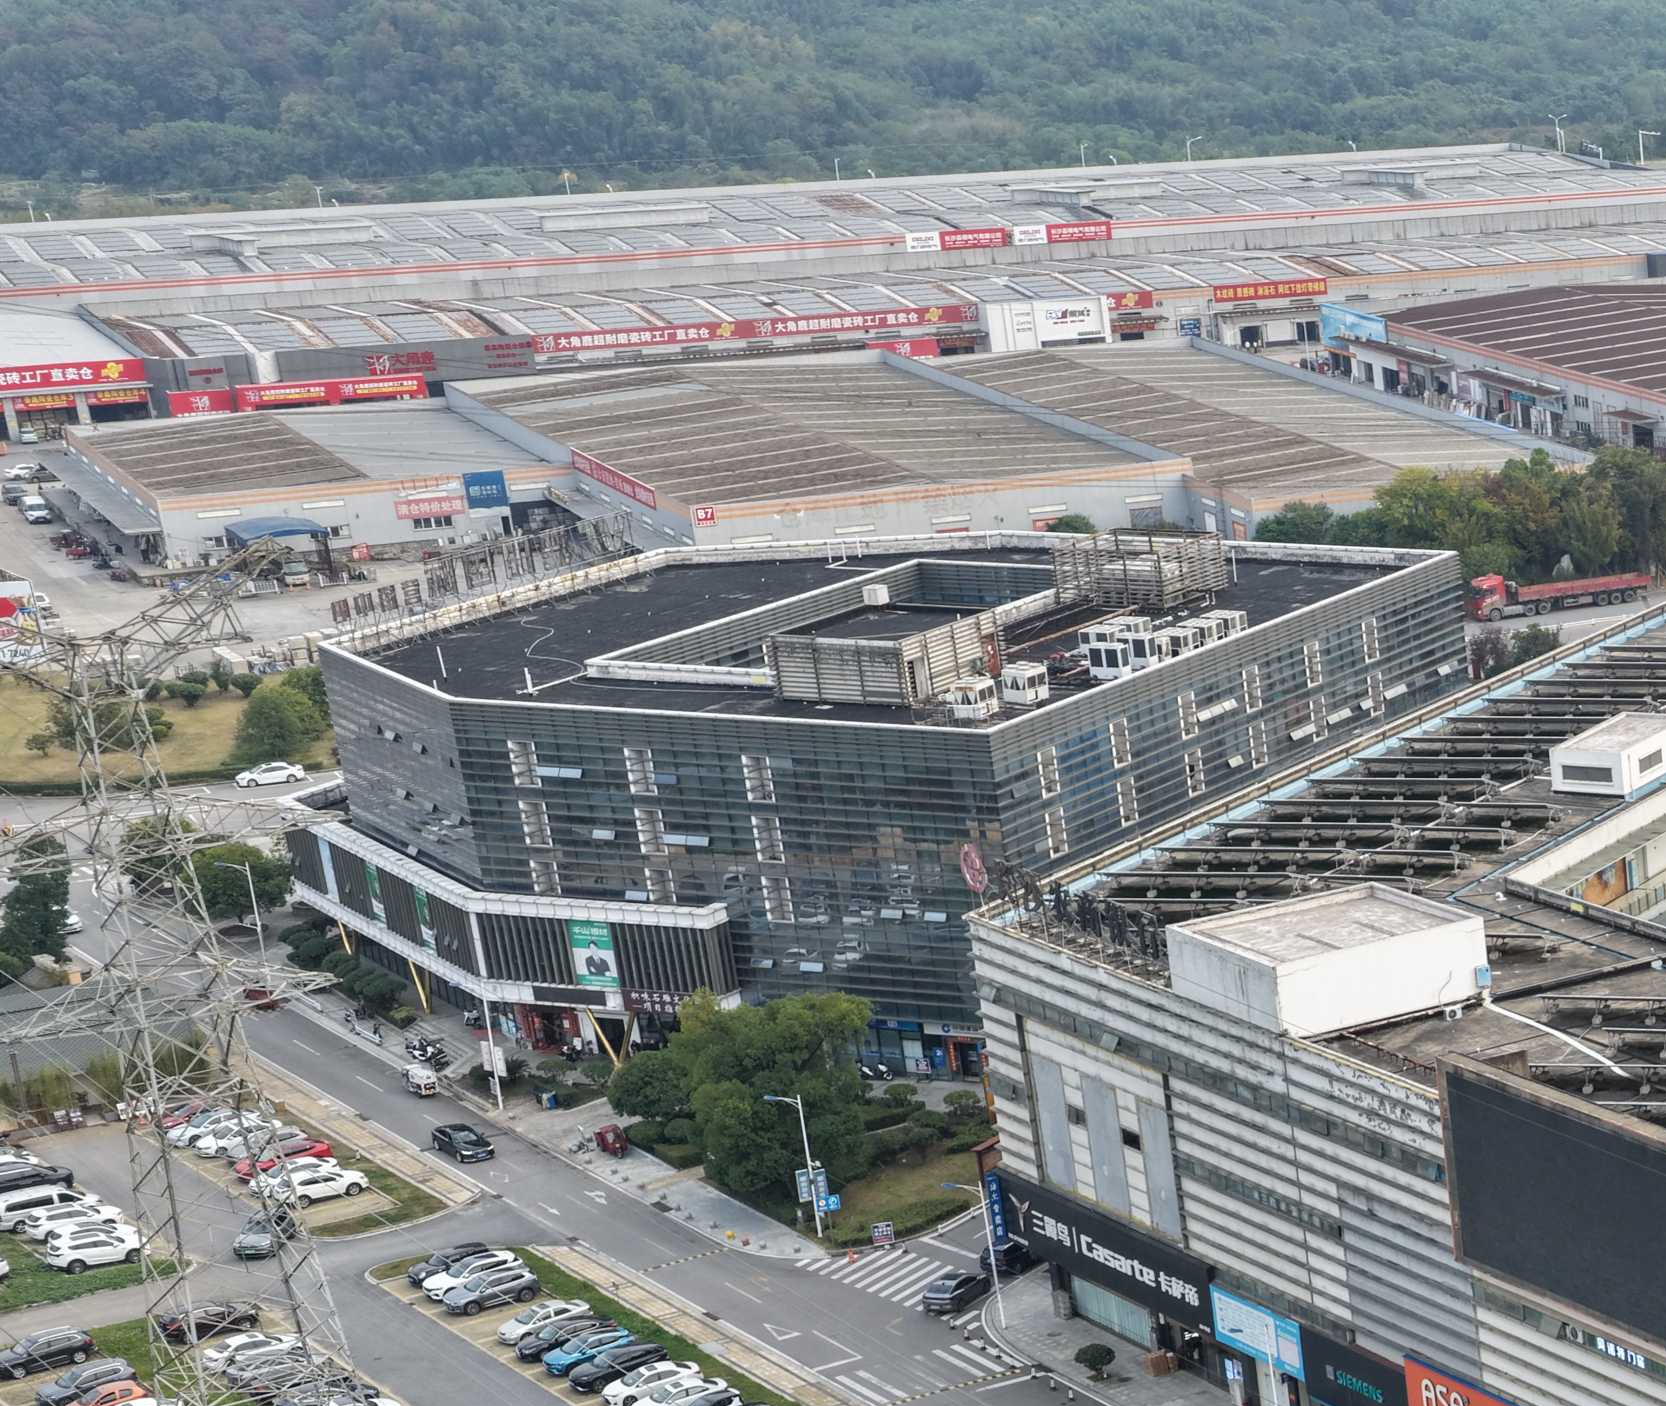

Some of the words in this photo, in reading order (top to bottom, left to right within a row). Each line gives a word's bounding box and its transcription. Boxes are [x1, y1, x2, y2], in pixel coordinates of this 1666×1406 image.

[696, 508, 713, 519] B7
[1032, 1210, 1071, 1247] 三翼鸟
[1080, 1234, 1157, 1287] Casarte
[1158, 1272, 1200, 1307] 卡萨帝
[1336, 1371, 1383, 1404] SIEMENS
